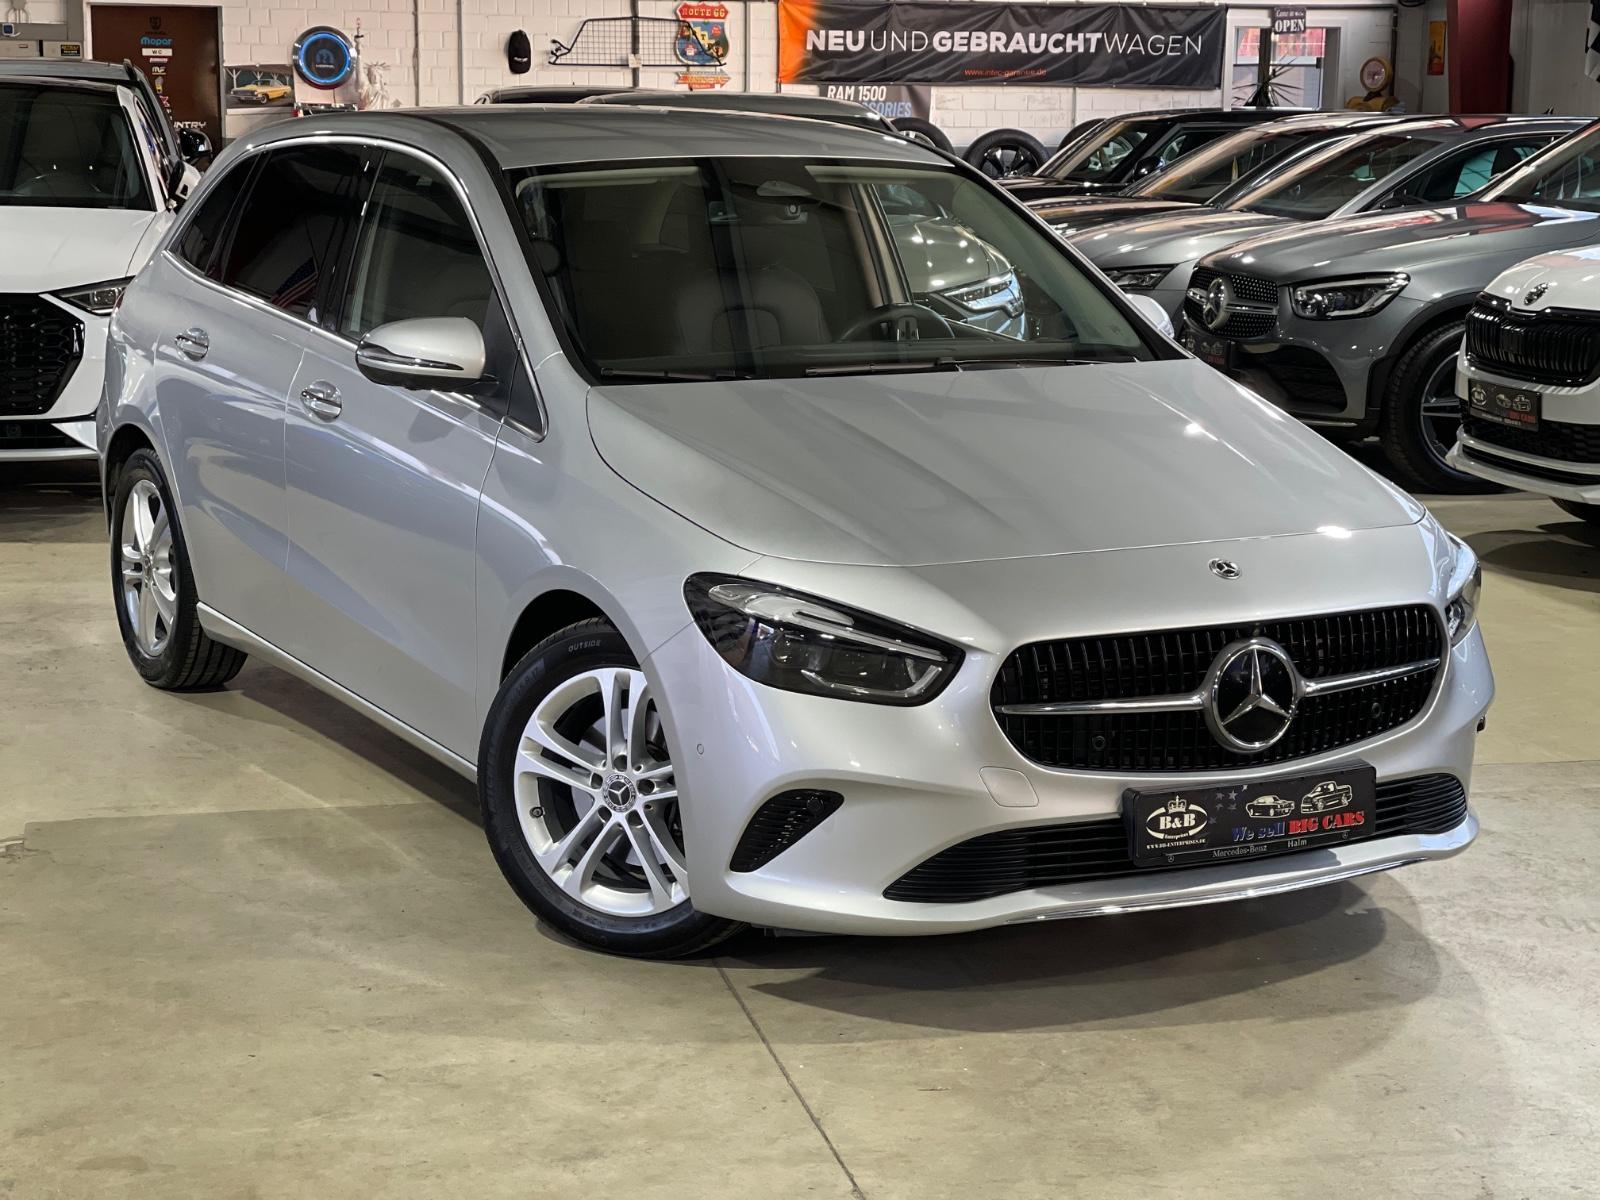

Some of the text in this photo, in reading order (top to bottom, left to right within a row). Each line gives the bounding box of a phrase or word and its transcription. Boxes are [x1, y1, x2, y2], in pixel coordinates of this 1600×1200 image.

[681, 8, 725, 17] ROUTE 66
[1274, 19, 1305, 32] OPEN
[806, 30, 865, 52] NEU
[870, 30, 928, 52] UND
[827, 86, 887, 101] RAM 1500
[568, 640, 602, 652] OUTSIDE
[1160, 813, 1196, 830] B&B
[1232, 811, 1365, 842] We sell BIG CARS
[1212, 840, 1308, 858] Mercedes-Benz Halm
